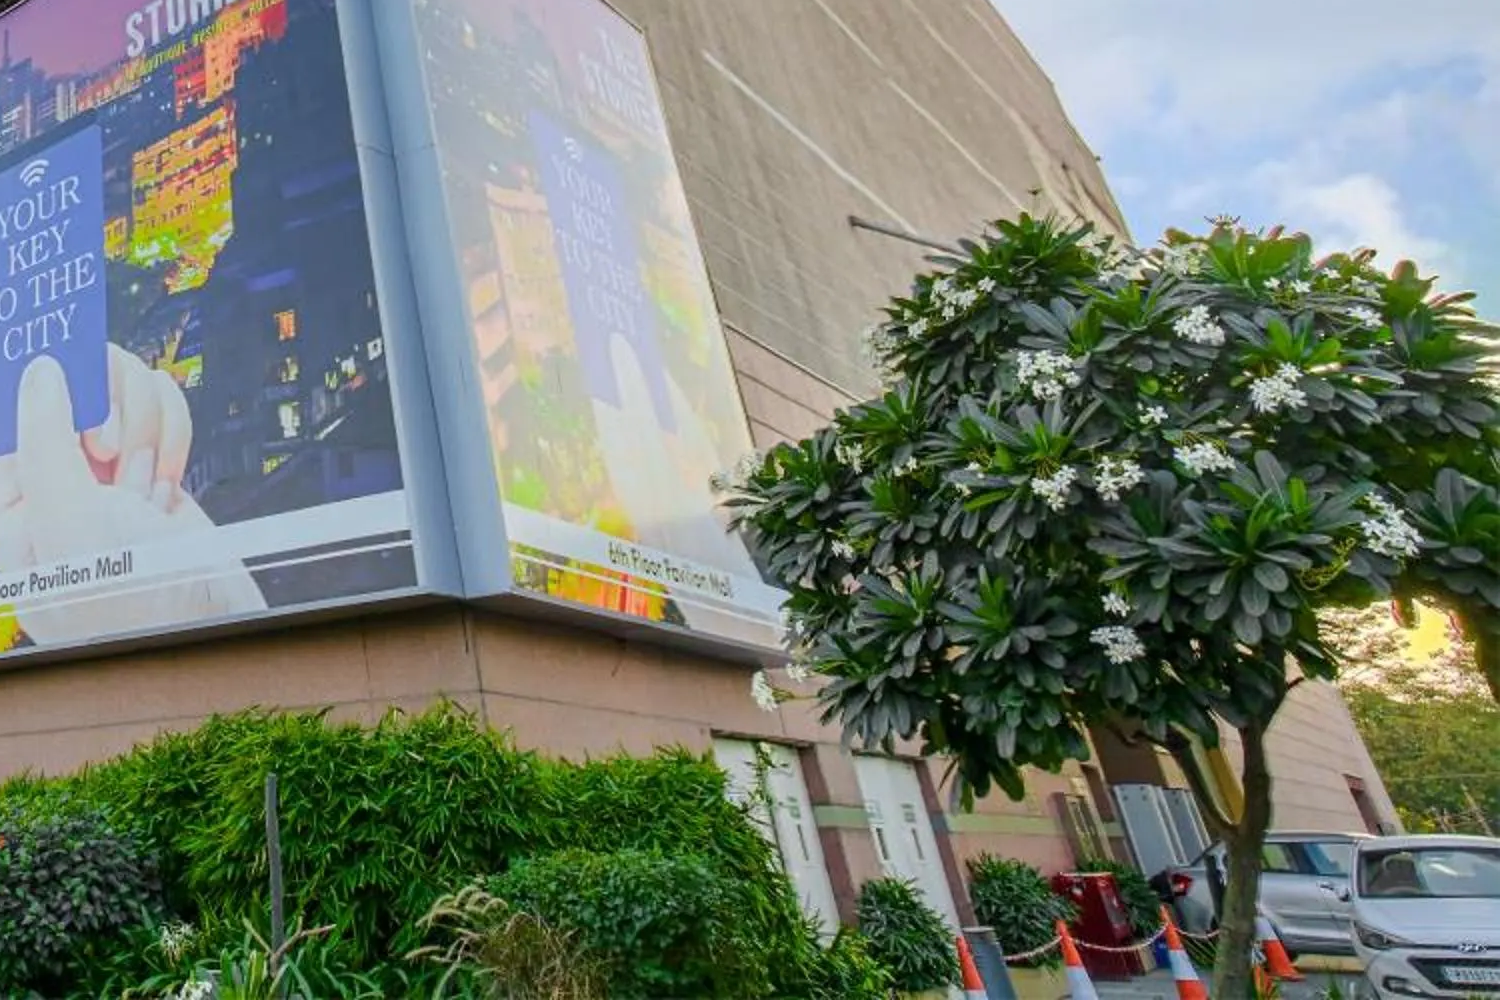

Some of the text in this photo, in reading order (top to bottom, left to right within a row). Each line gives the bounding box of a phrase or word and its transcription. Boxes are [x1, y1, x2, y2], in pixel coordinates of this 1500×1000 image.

[8, 219, 71, 276] KEY
[27, 252, 96, 309] THE
[3, 303, 77, 361] CITY
[29, 566, 91, 593] Pavilion
[96, 551, 133, 577] Mall
